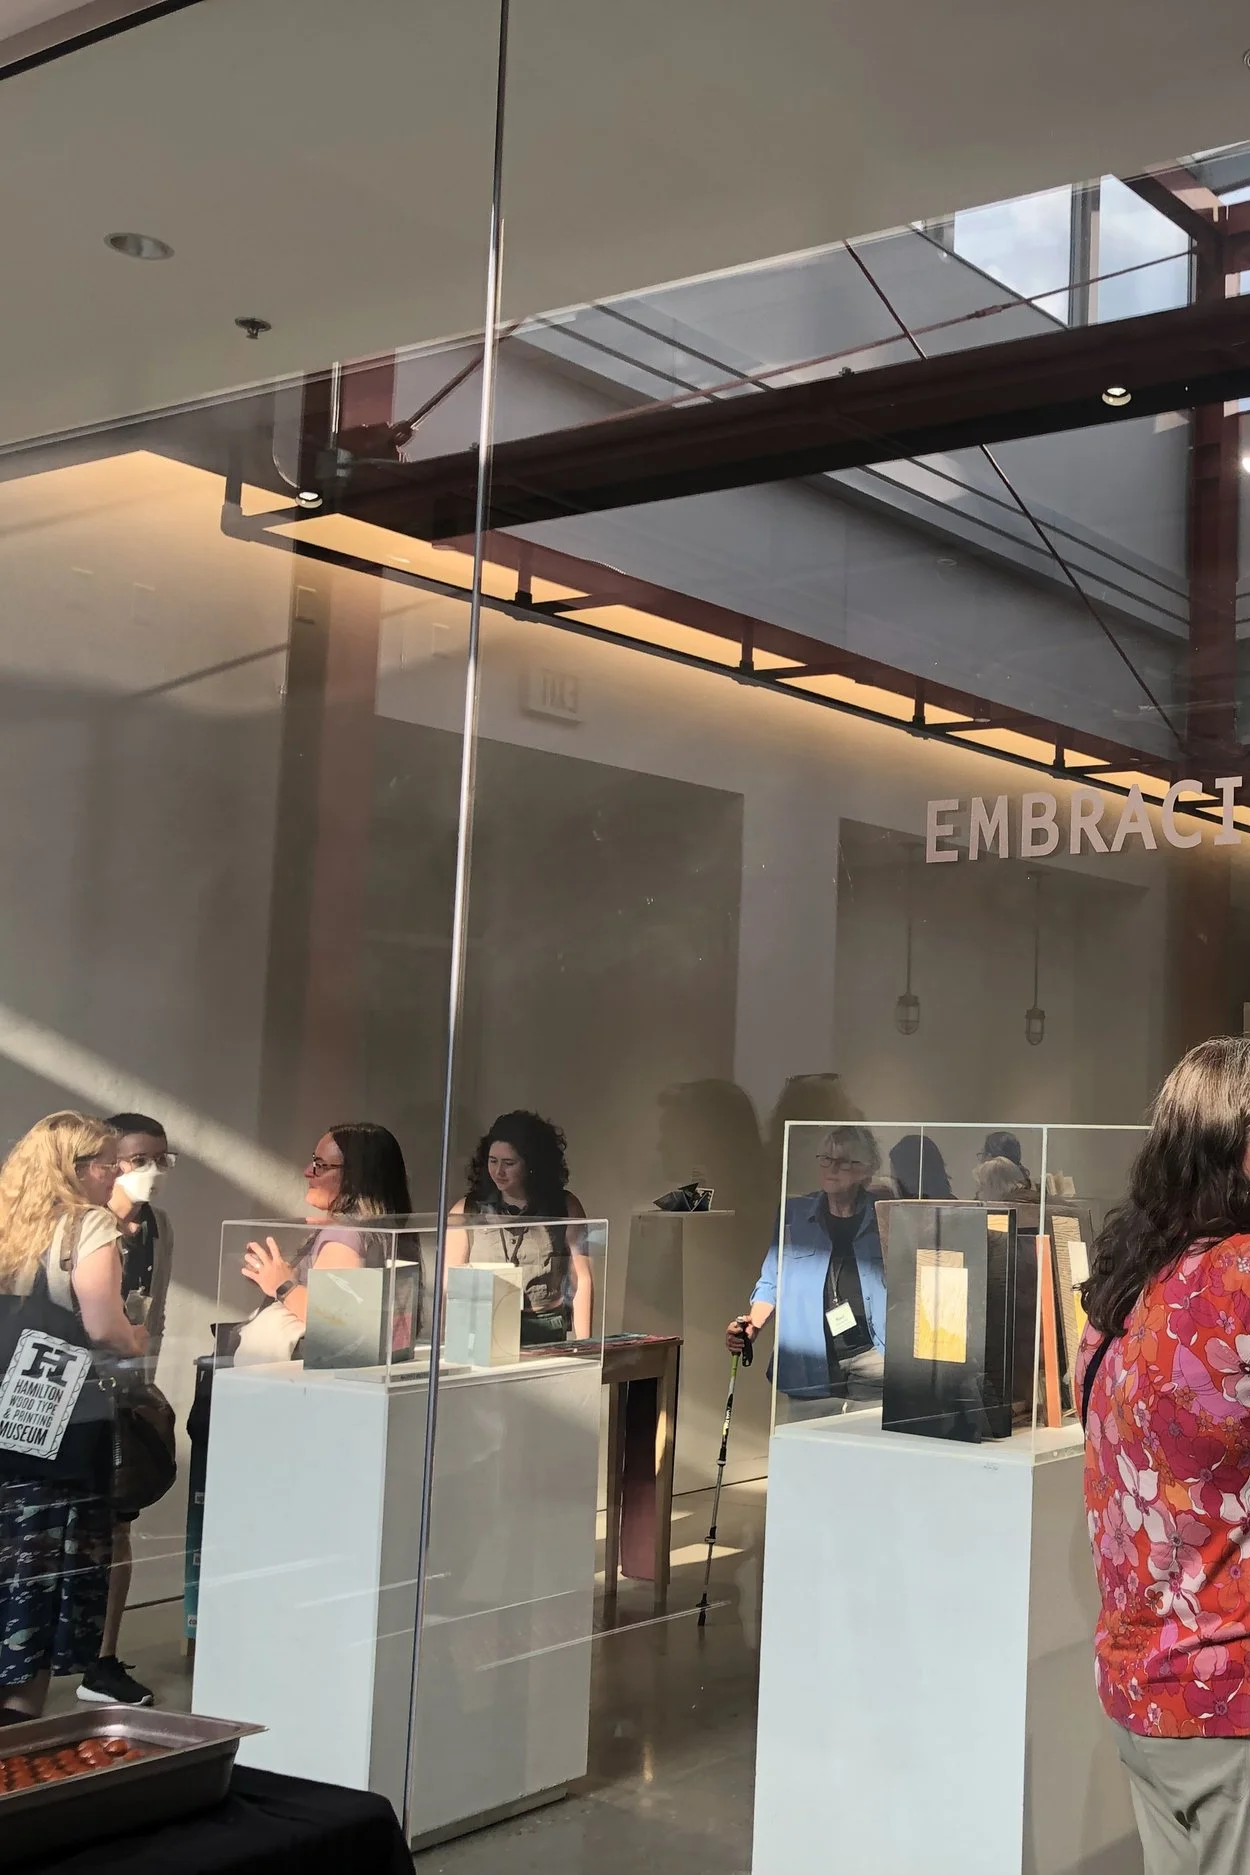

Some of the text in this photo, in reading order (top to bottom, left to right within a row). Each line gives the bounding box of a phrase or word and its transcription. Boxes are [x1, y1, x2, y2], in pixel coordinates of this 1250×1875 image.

[14, 1379, 64, 1403] HAMILTON
[9, 1395, 58, 1415] WOOD TYPE
[3, 1408, 53, 1428] & PRINTING
[0, 1420, 49, 1446] MUSEUM
